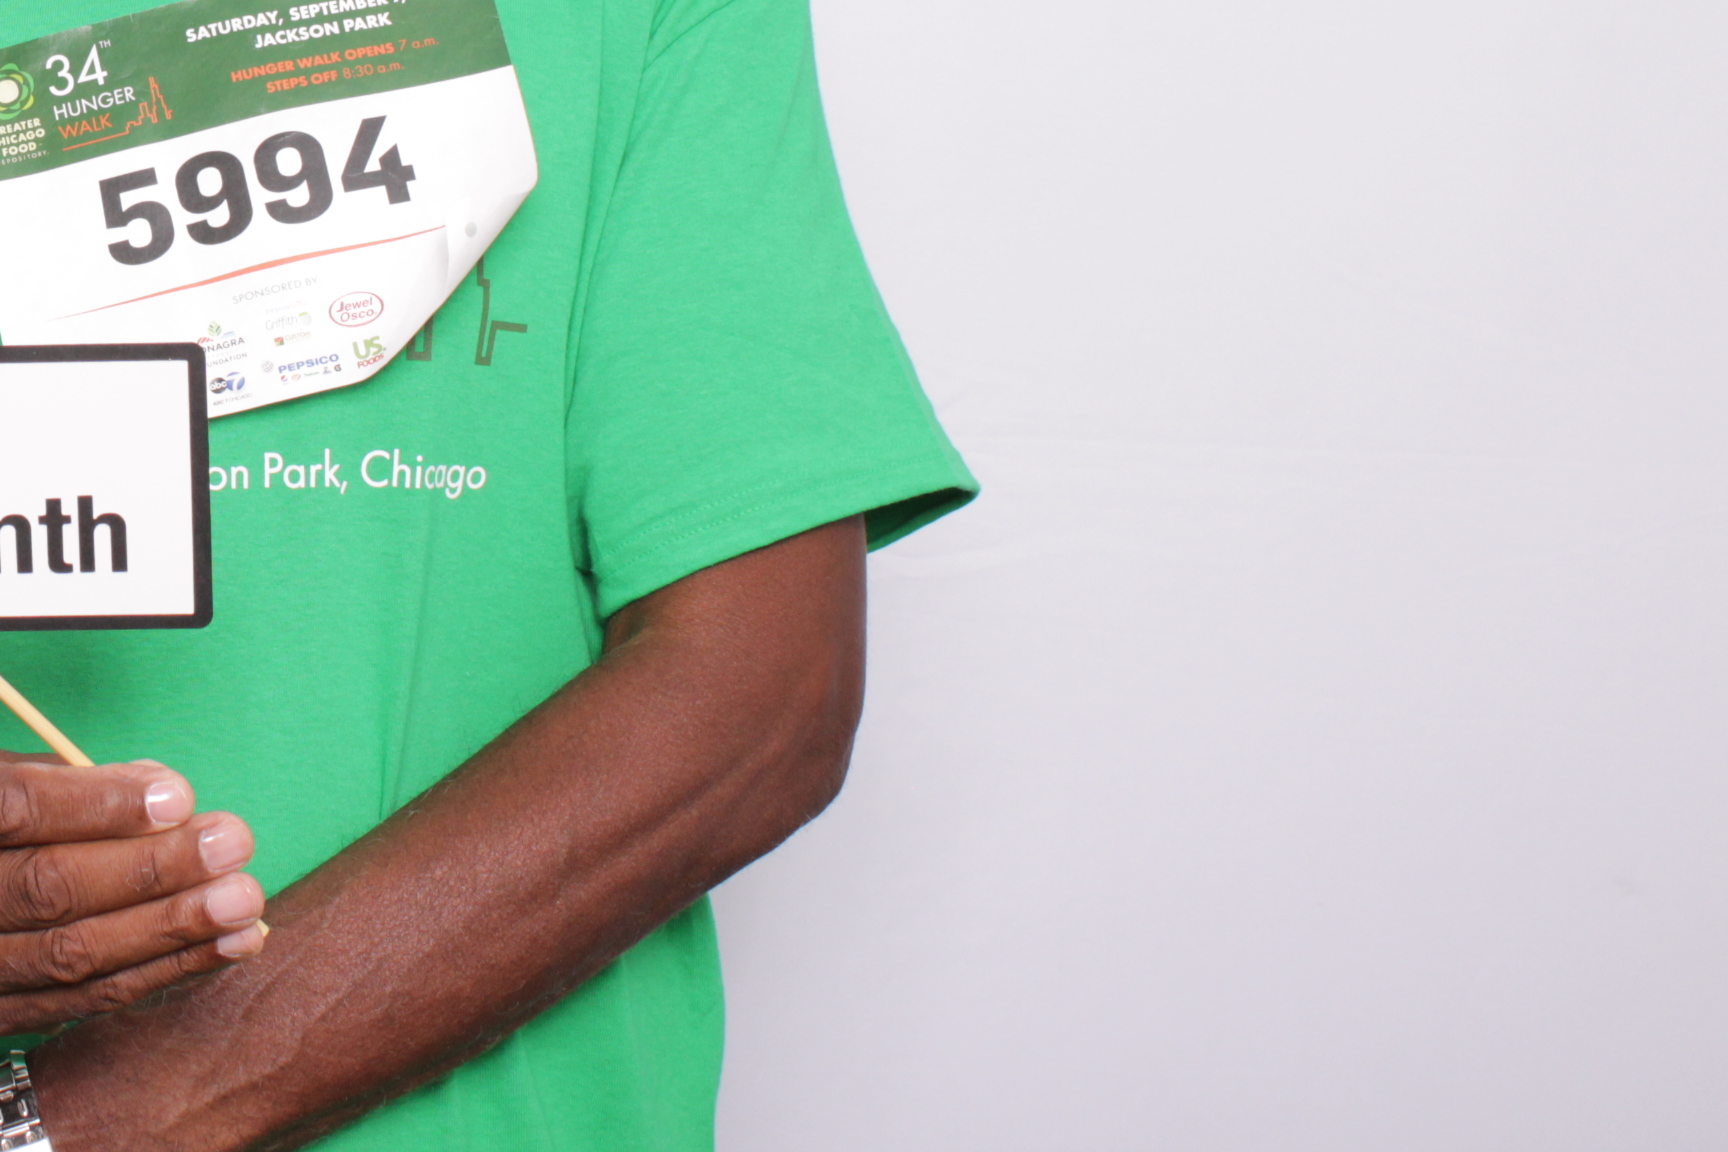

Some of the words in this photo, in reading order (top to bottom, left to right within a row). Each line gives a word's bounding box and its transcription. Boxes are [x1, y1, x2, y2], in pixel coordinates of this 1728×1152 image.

[185, 10, 284, 43] SATURDAY,
[254, 22, 340, 49] JACKSON
[343, 12, 392, 33] PARK
[230, 60, 296, 83] HUNGER
[296, 51, 342, 70] WALK
[344, 42, 395, 61] OPENS
[398, 39, 407, 52] 7
[411, 36, 440, 50] a.m.
[265, 74, 308, 94] STEPS
[310, 69, 339, 86] OFF
[342, 64, 374, 80] 8:30
[377, 60, 405, 74] a.m.
[53, 86, 136, 121] HUNGER
[58, 113, 114, 139] WALK
[98, 115, 416, 266] 5994
[232, 280, 302, 305] SPONSORED
[336, 296, 373, 313] Jewel
[206, 352, 248, 367] UNDATION
[277, 353, 340, 374] PEPSICO
[357, 353, 385, 368] FOODS
[263, 448, 348, 495] Park,
[360, 448, 487, 500] Chicago
